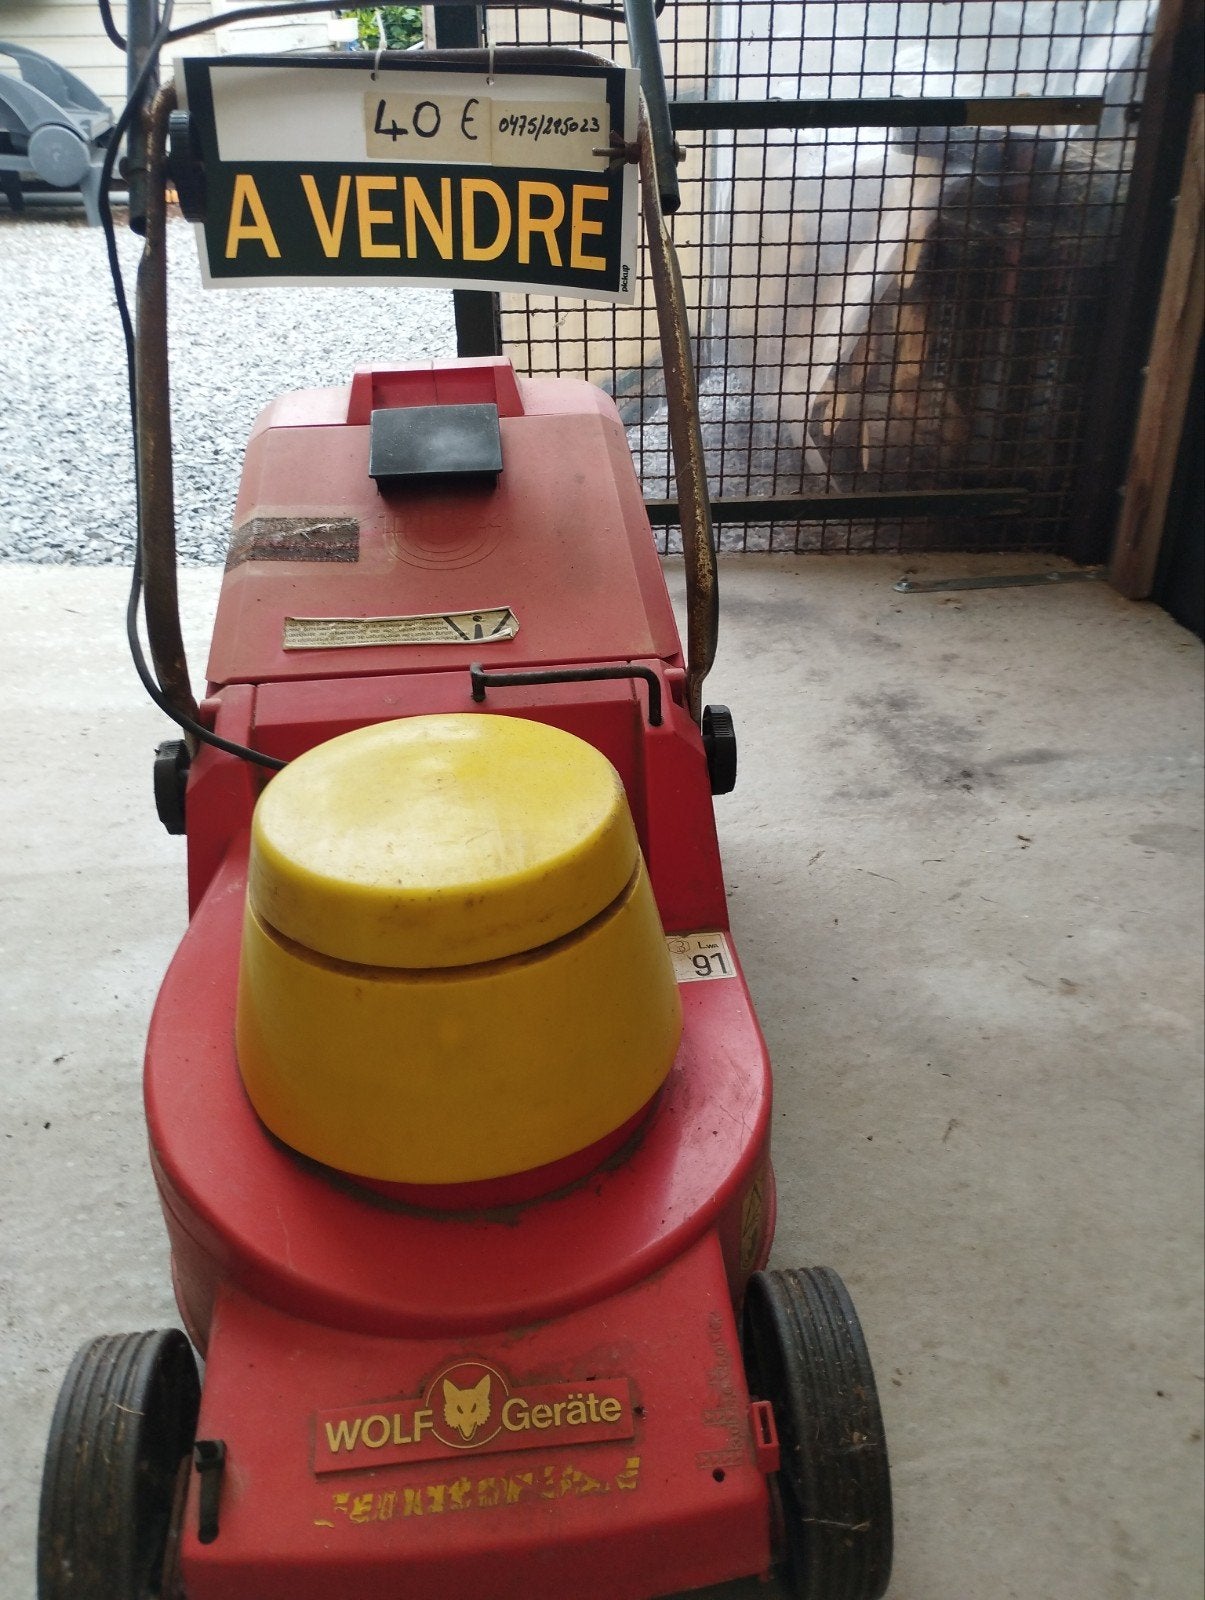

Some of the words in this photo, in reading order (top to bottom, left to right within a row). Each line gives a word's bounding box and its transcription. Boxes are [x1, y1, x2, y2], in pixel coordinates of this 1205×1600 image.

[375, 99, 442, 141] 40
[460, 98, 480, 140] €
[225, 174, 281, 258] A
[300, 175, 609, 271] VENDRE
[621, 264, 630, 292] pickup
[692, 952, 727, 976] 91
[325, 1409, 433, 1453] WOLF
[501, 1393, 622, 1432] Geräte
